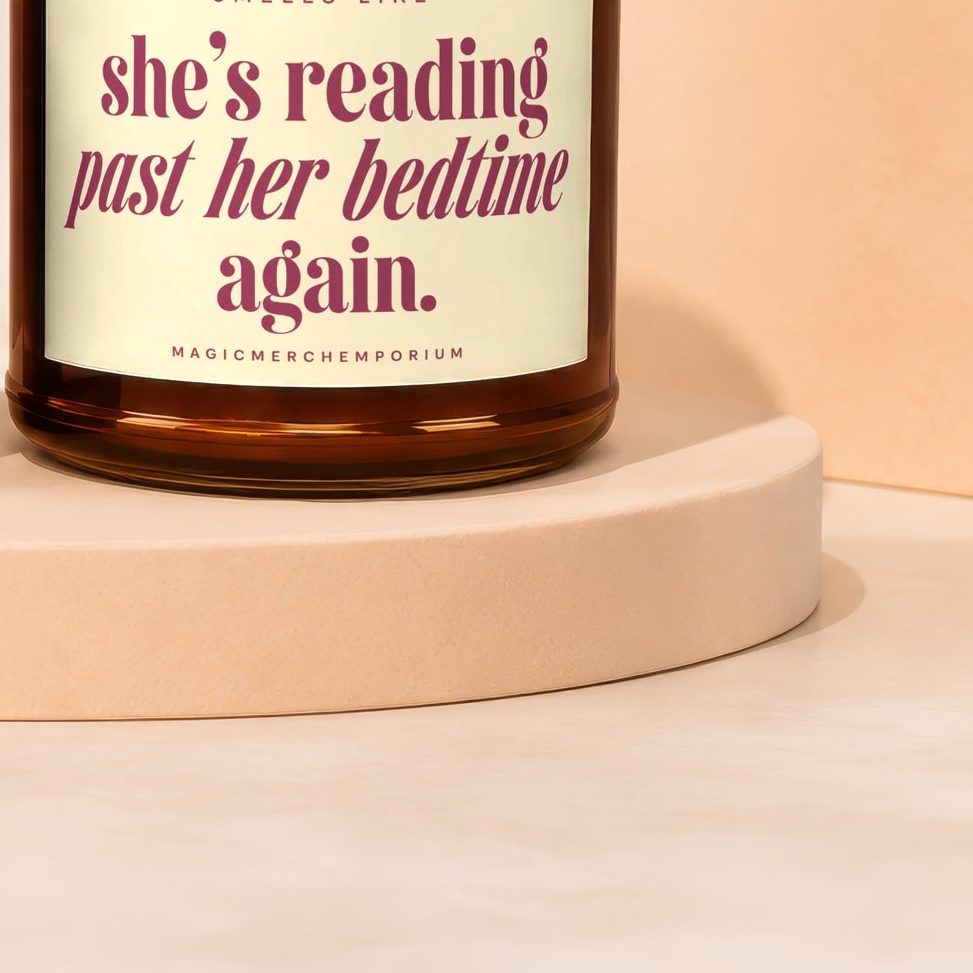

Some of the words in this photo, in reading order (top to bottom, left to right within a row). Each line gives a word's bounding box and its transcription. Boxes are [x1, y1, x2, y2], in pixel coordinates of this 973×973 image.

[101, 31, 261, 121] she’s
[286, 37, 548, 139] reading
[65, 143, 194, 229] past
[205, 137, 330, 220] her
[343, 135, 569, 221] bedtime
[217, 236, 436, 333] again.
[172, 346, 465, 363] MAGICMERCHEMPORIUM
